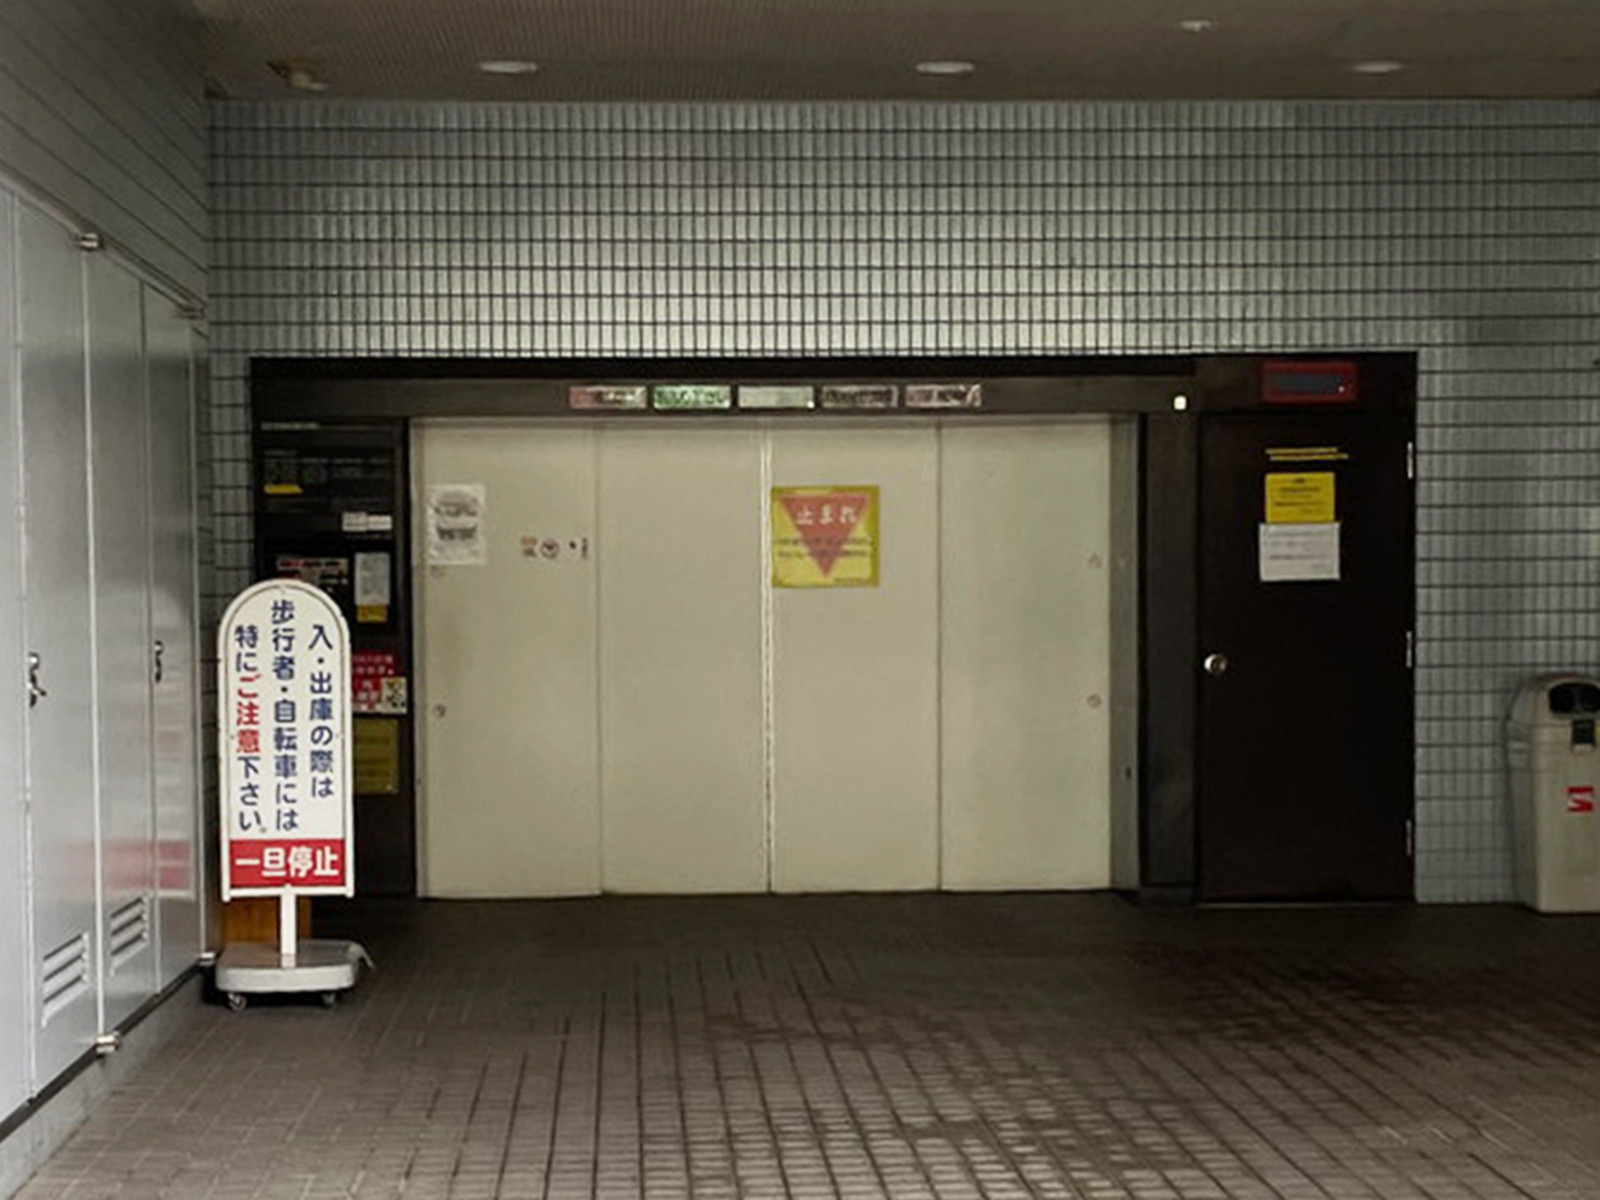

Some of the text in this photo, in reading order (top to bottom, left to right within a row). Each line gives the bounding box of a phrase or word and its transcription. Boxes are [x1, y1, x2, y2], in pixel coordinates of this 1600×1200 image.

[795, 503, 857, 525] 止まれ
[270, 599, 299, 831] 歩行者・自転車には
[308, 624, 334, 798] 入・出庫の際は
[235, 845, 339, 878] 一旦停止
